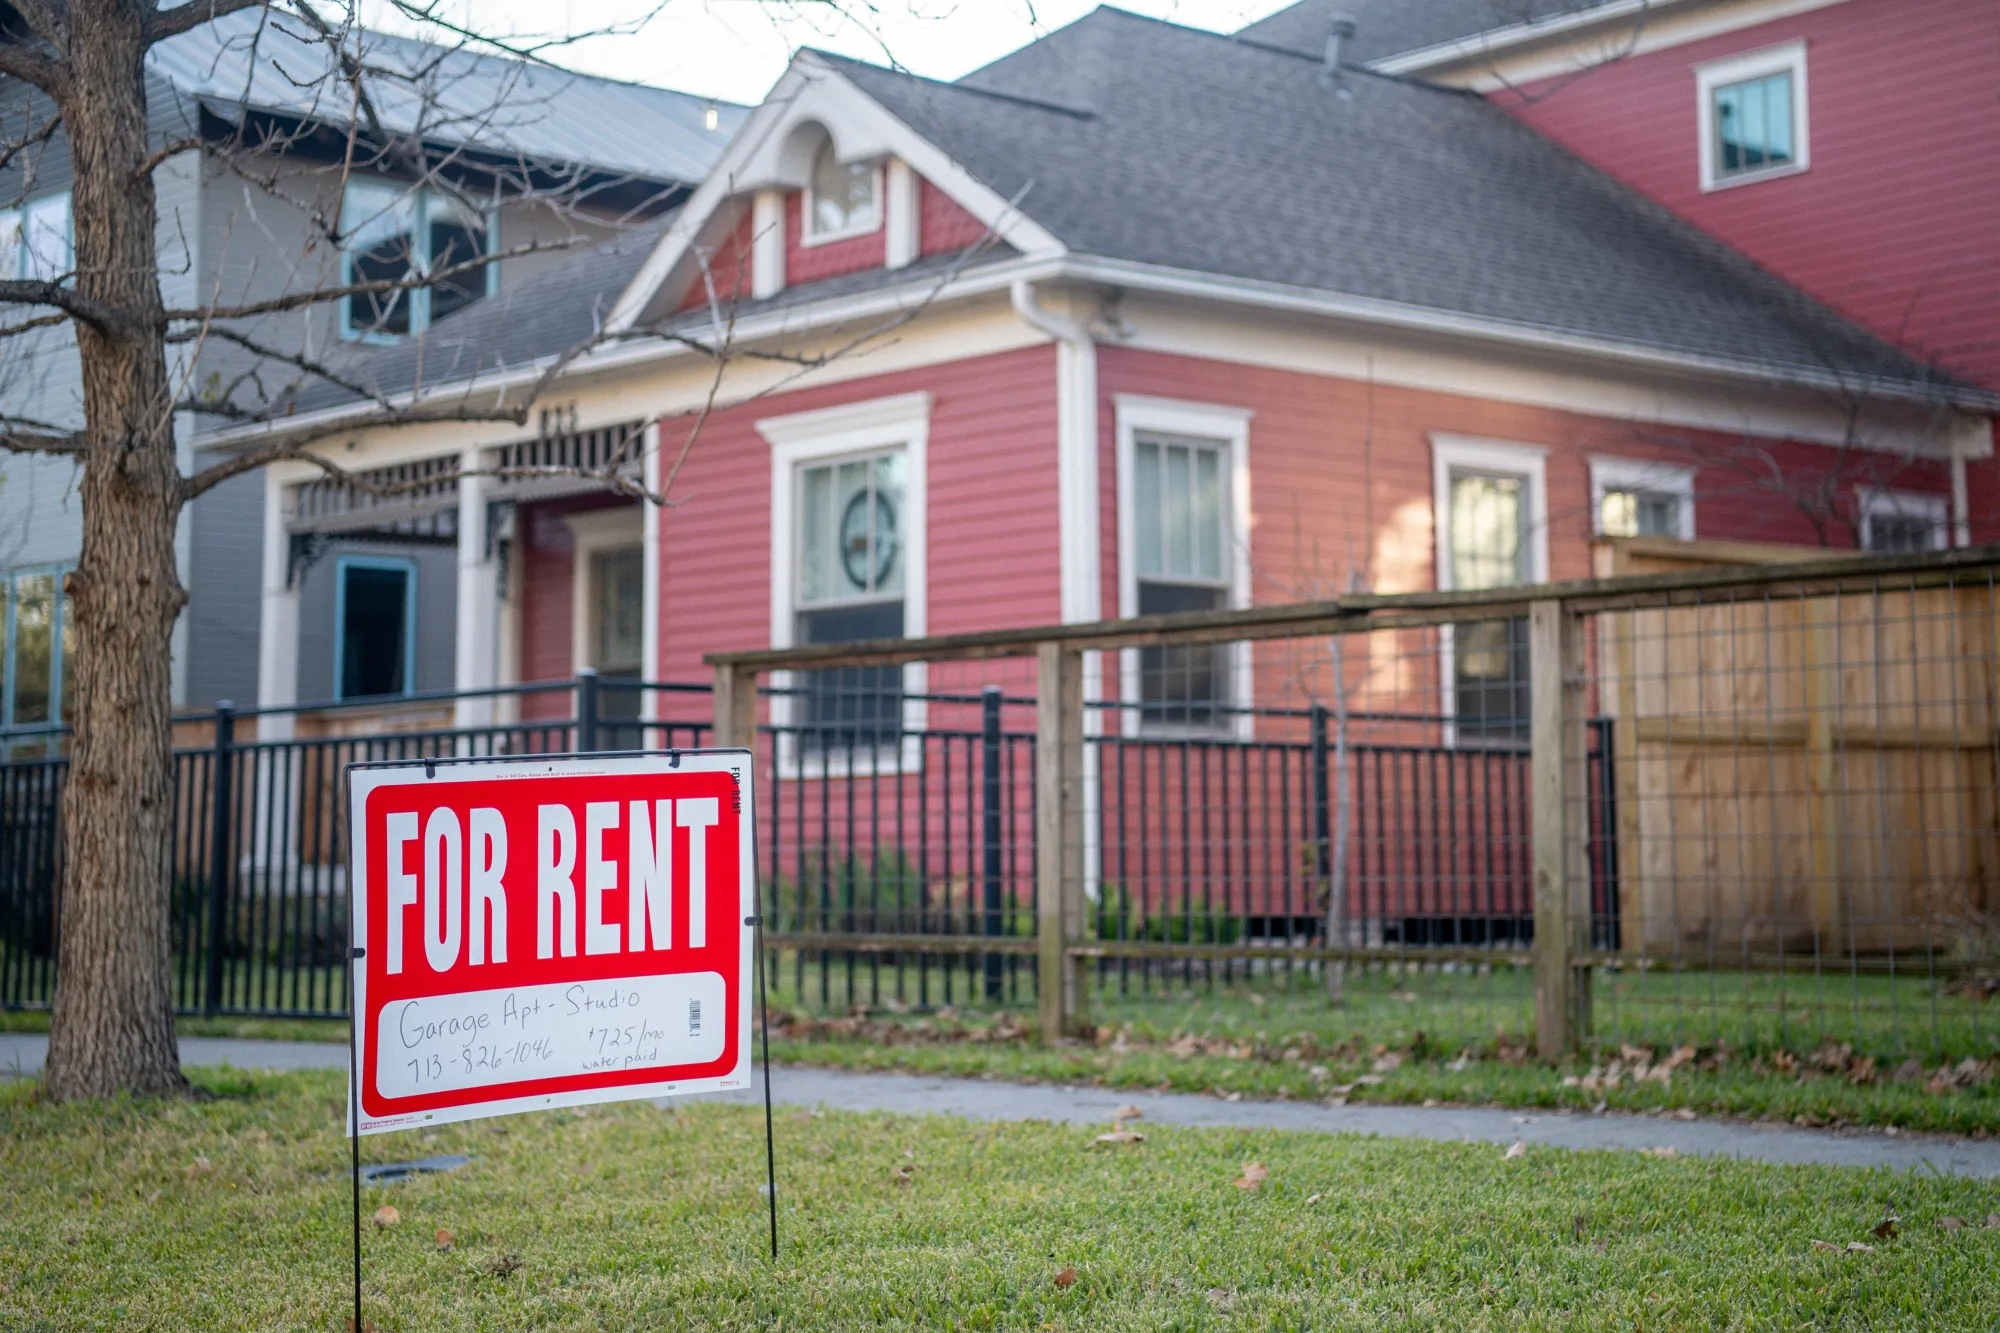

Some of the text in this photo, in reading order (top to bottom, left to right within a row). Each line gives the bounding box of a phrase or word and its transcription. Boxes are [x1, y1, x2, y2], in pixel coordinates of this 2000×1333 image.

[731, 767, 742, 815] FOR RENT
[386, 797, 719, 975] FOR RENT
[400, 1000, 491, 1049] Garage
[566, 984, 640, 1016] Studio
[582, 1047, 657, 1070] water paid
